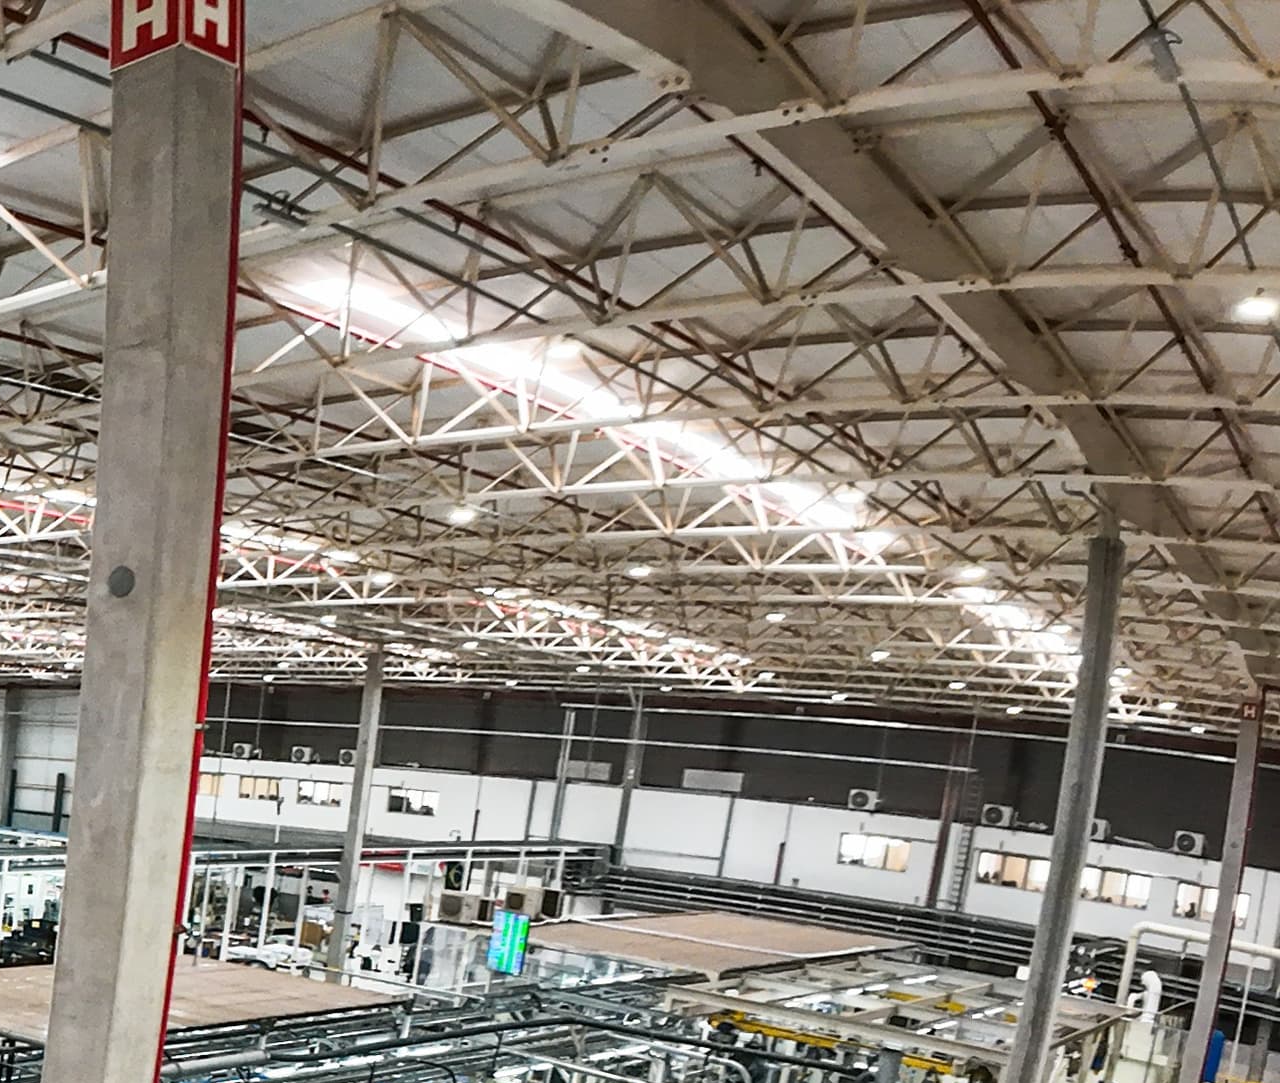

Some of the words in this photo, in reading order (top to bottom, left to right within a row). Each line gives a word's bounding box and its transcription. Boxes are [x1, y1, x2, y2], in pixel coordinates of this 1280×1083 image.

[122, 0, 168, 52] H
[193, 0, 229, 48] H
[1243, 704, 1257, 718] H
